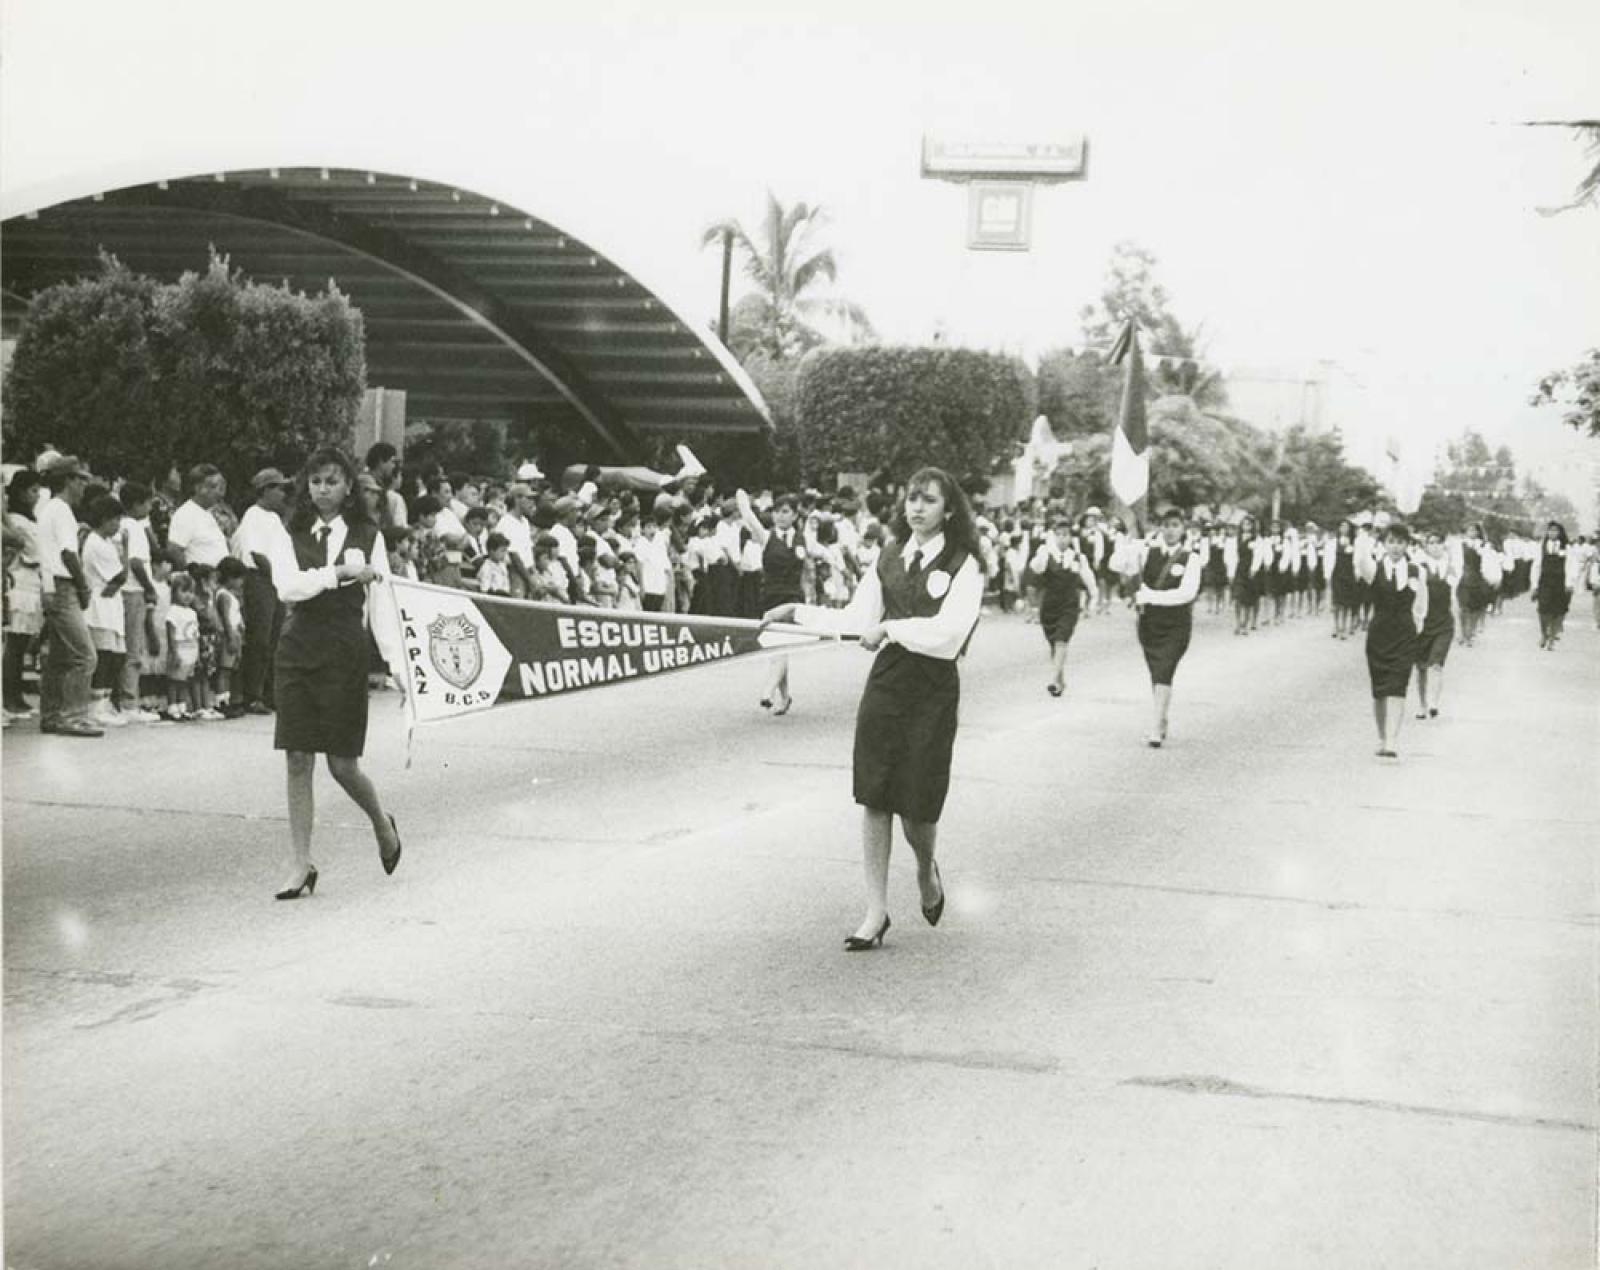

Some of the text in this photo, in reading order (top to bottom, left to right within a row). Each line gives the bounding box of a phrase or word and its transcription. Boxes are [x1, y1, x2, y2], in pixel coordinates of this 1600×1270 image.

[401, 608, 428, 695] LA PAZ
[557, 617, 695, 648] ESCUELA
[519, 652, 637, 696] NORMAL
